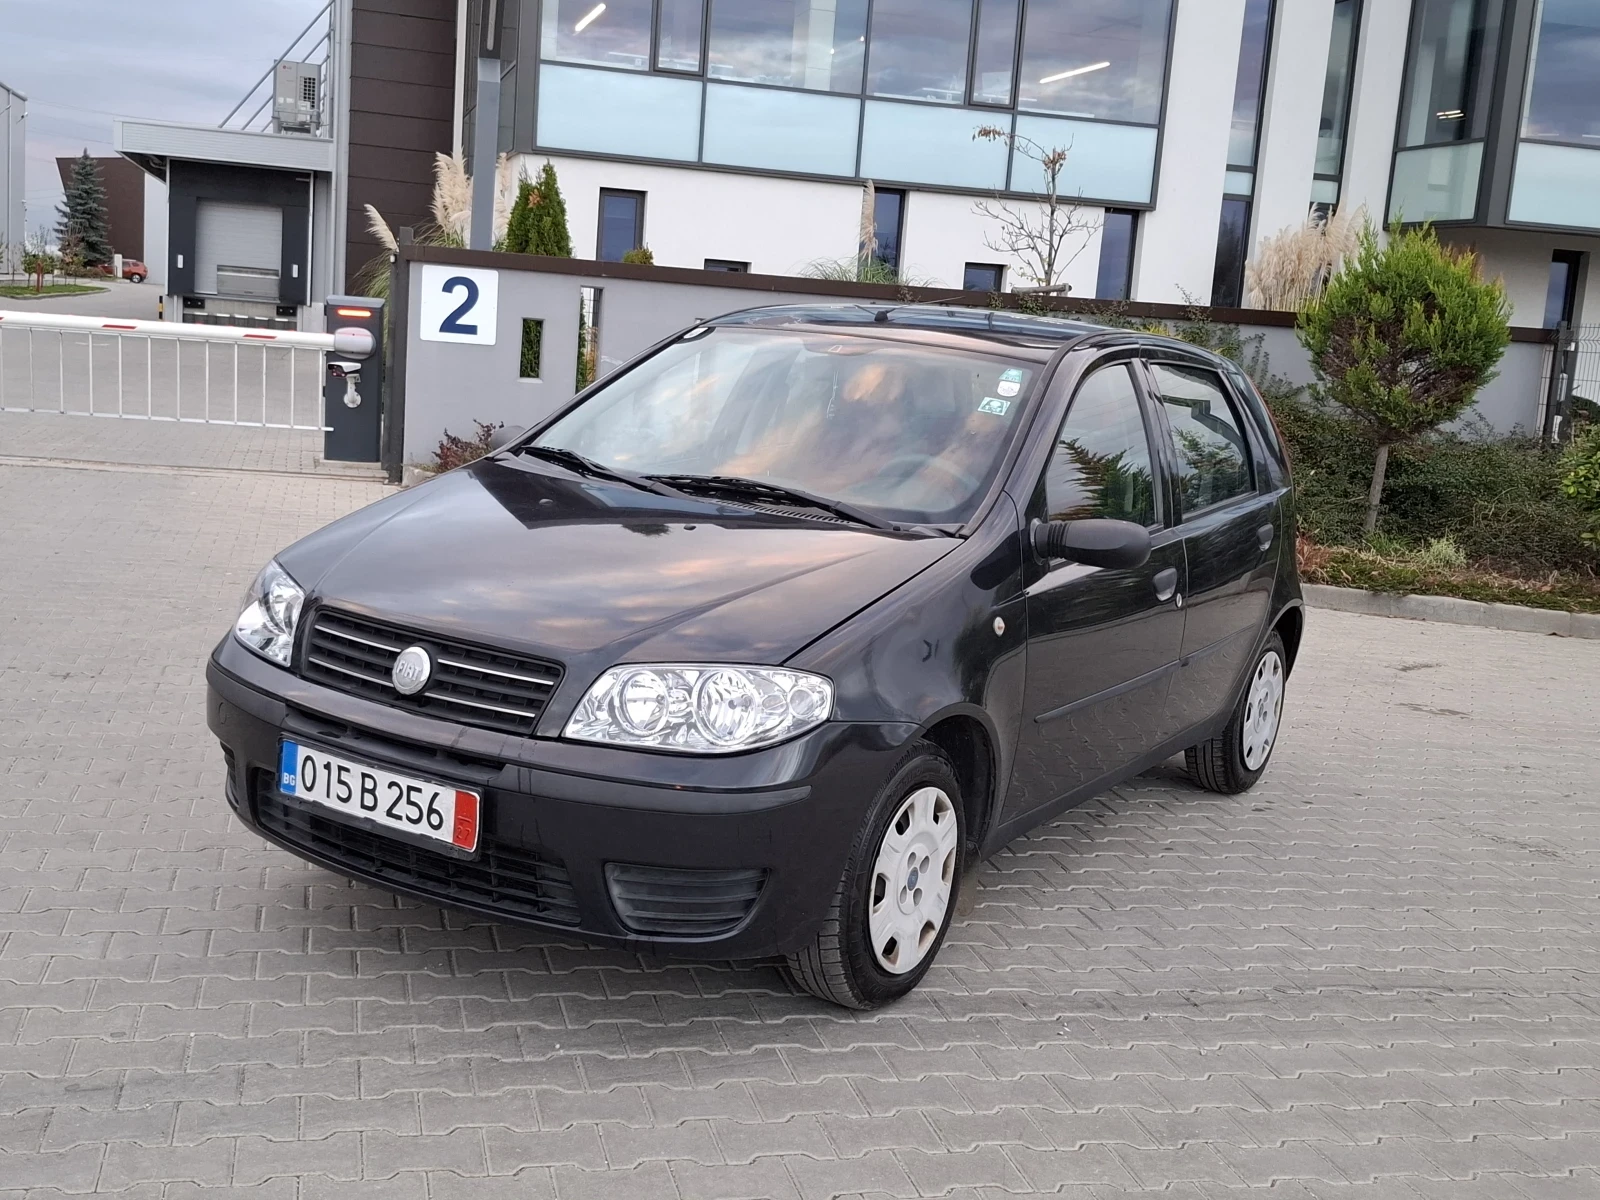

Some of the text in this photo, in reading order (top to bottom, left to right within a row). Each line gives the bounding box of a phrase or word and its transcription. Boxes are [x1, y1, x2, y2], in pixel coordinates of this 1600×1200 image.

[439, 276, 479, 335] 2
[396, 660, 421, 680] FIAT
[283, 772, 296, 786] BG
